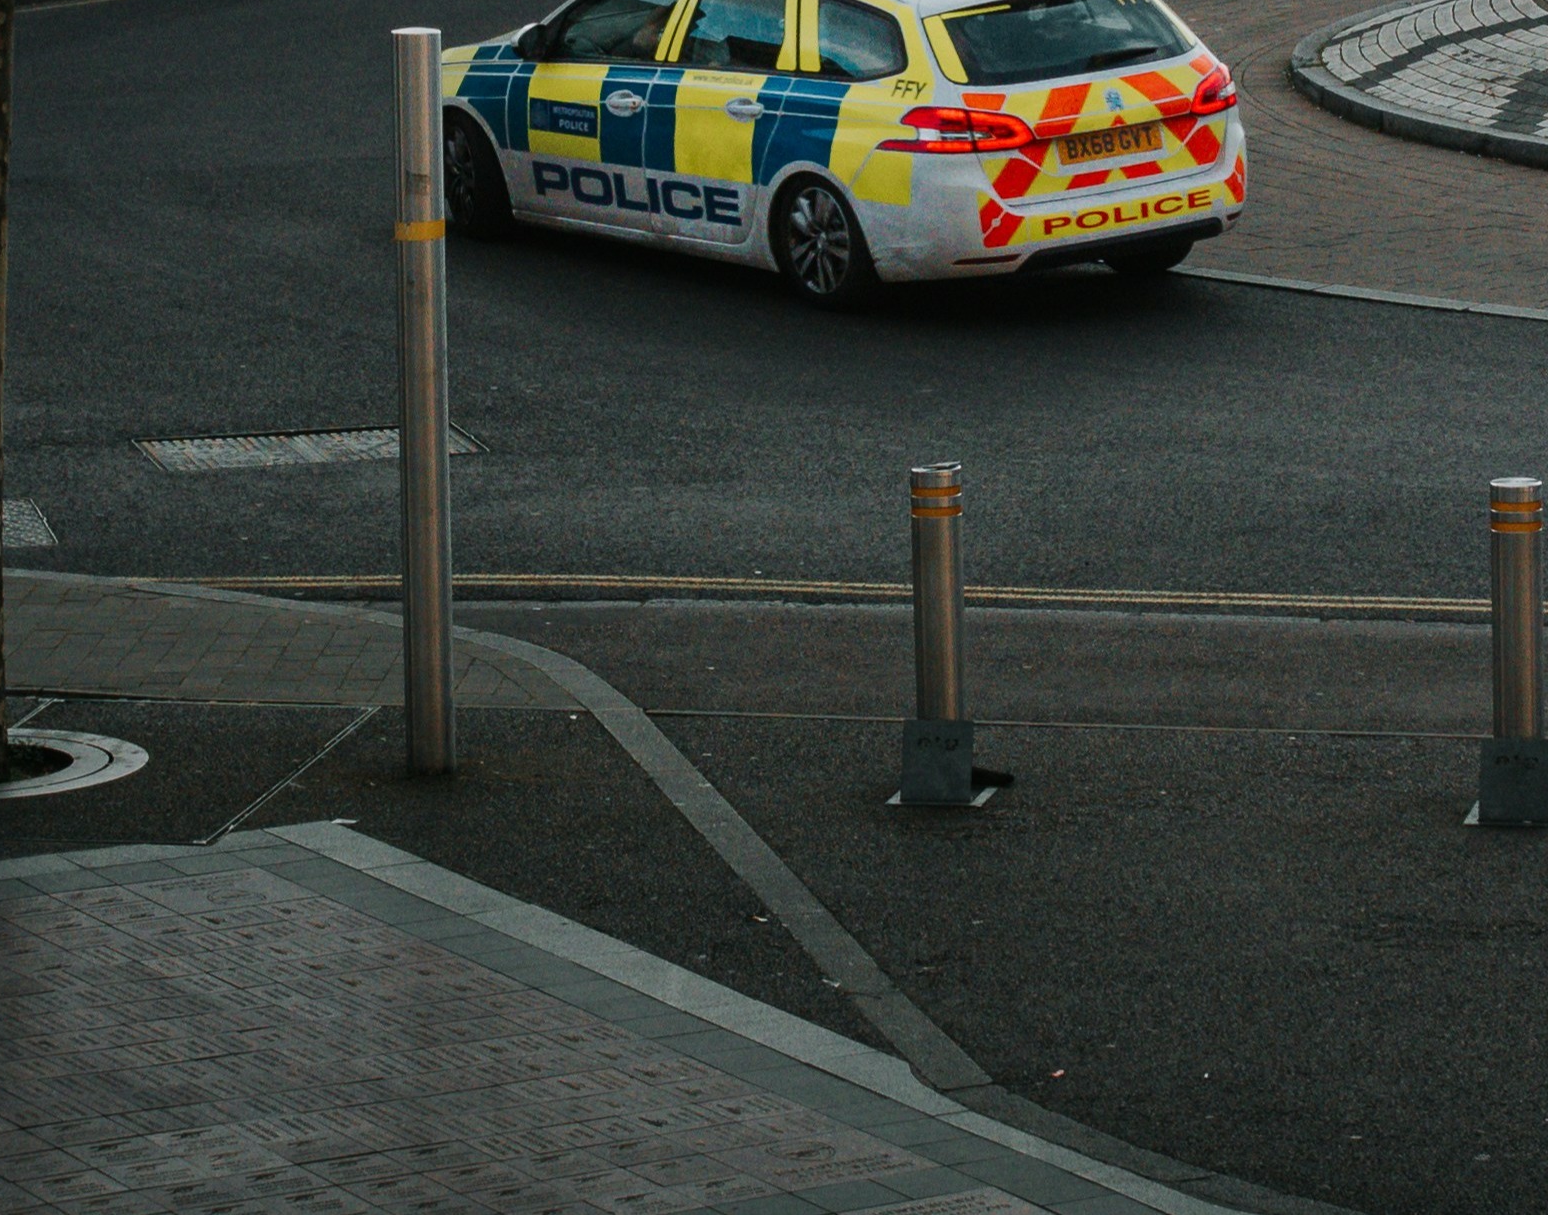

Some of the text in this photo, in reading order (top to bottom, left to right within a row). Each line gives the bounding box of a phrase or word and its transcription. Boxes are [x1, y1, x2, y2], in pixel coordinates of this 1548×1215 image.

[890, 79, 928, 99] FFY
[558, 118, 590, 133] POLICE
[532, 160, 742, 226] POLICE
[1043, 189, 1213, 235] POLICE
